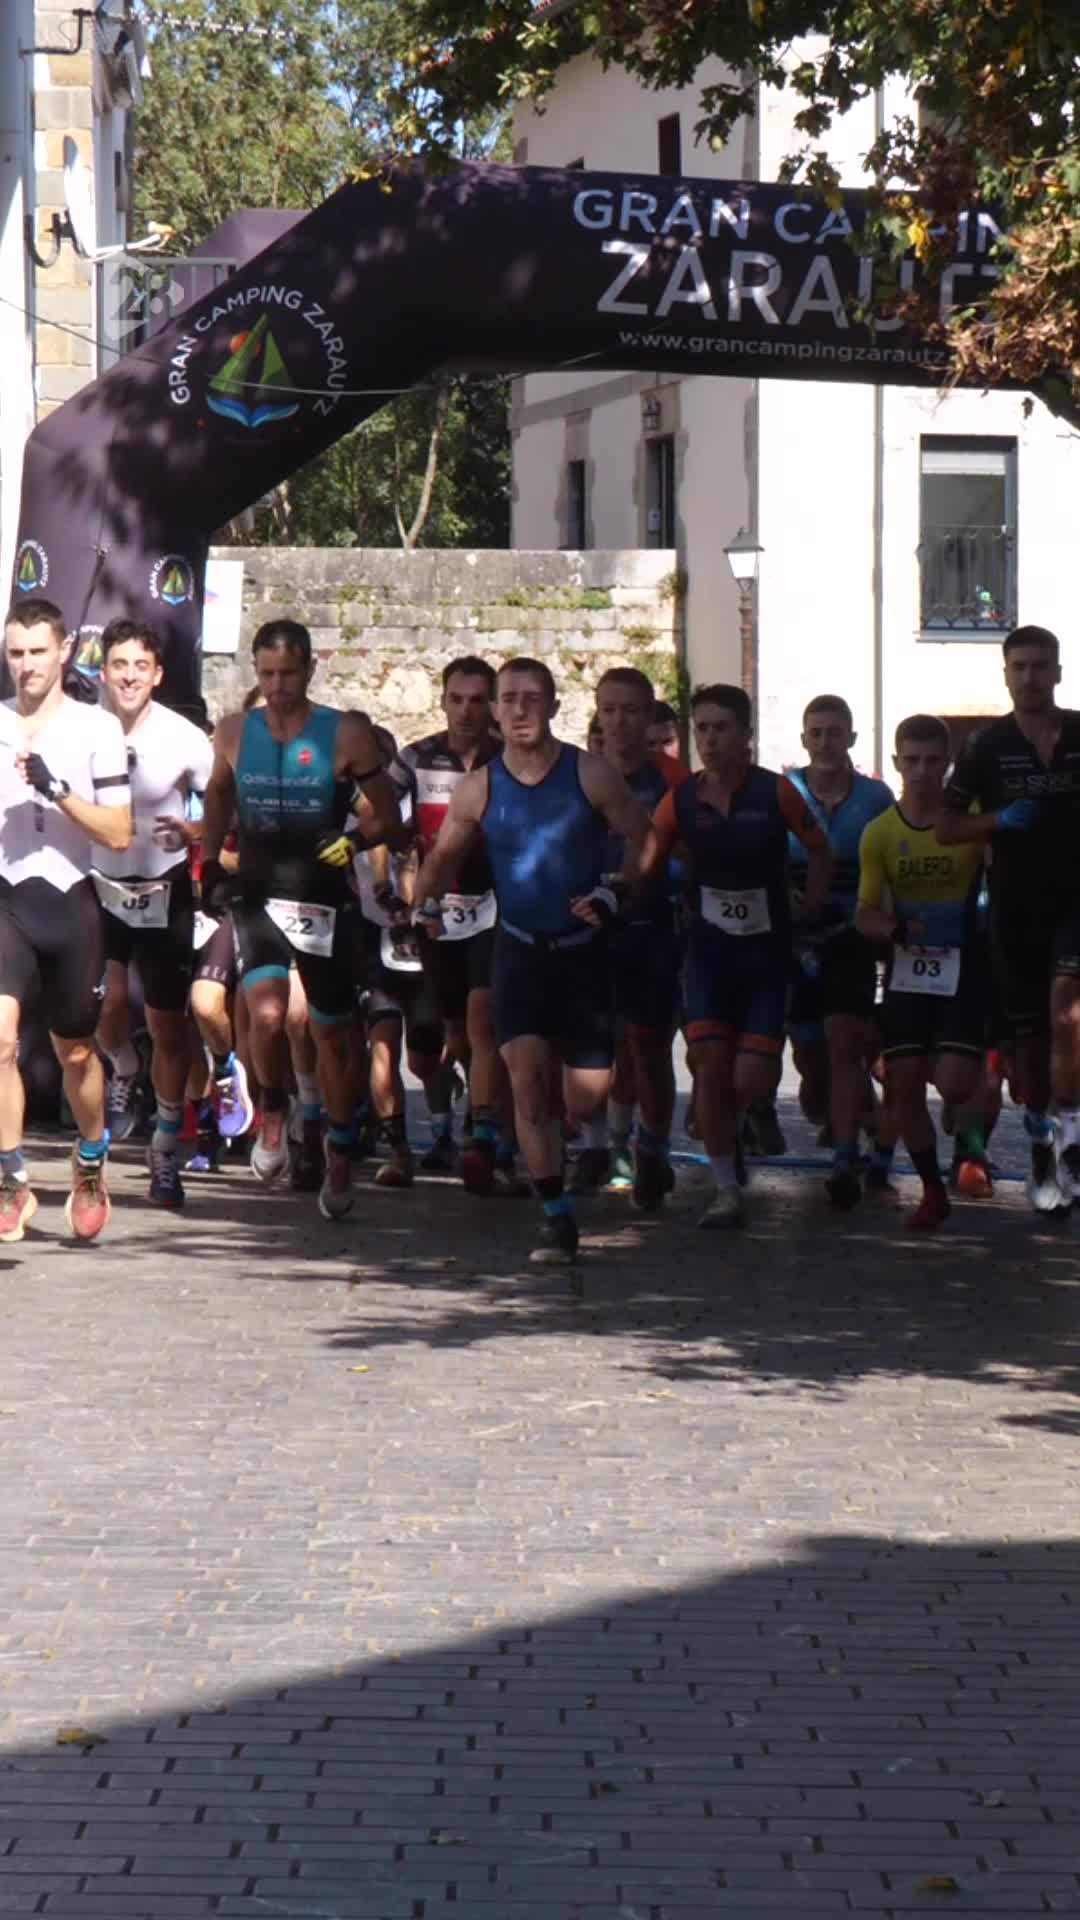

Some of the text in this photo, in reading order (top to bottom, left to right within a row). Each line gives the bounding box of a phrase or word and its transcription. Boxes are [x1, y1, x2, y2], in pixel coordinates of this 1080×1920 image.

[573, 188, 750, 240] GRAN
[597, 240, 1003, 332] ZARAUT
[168, 285, 348, 416] GRAN CAMPING ZARAUTZ
[452, 906, 478, 924] 31
[720, 902, 748, 920] 20
[284, 916, 314, 935] 22
[912, 958, 941, 977] 03
